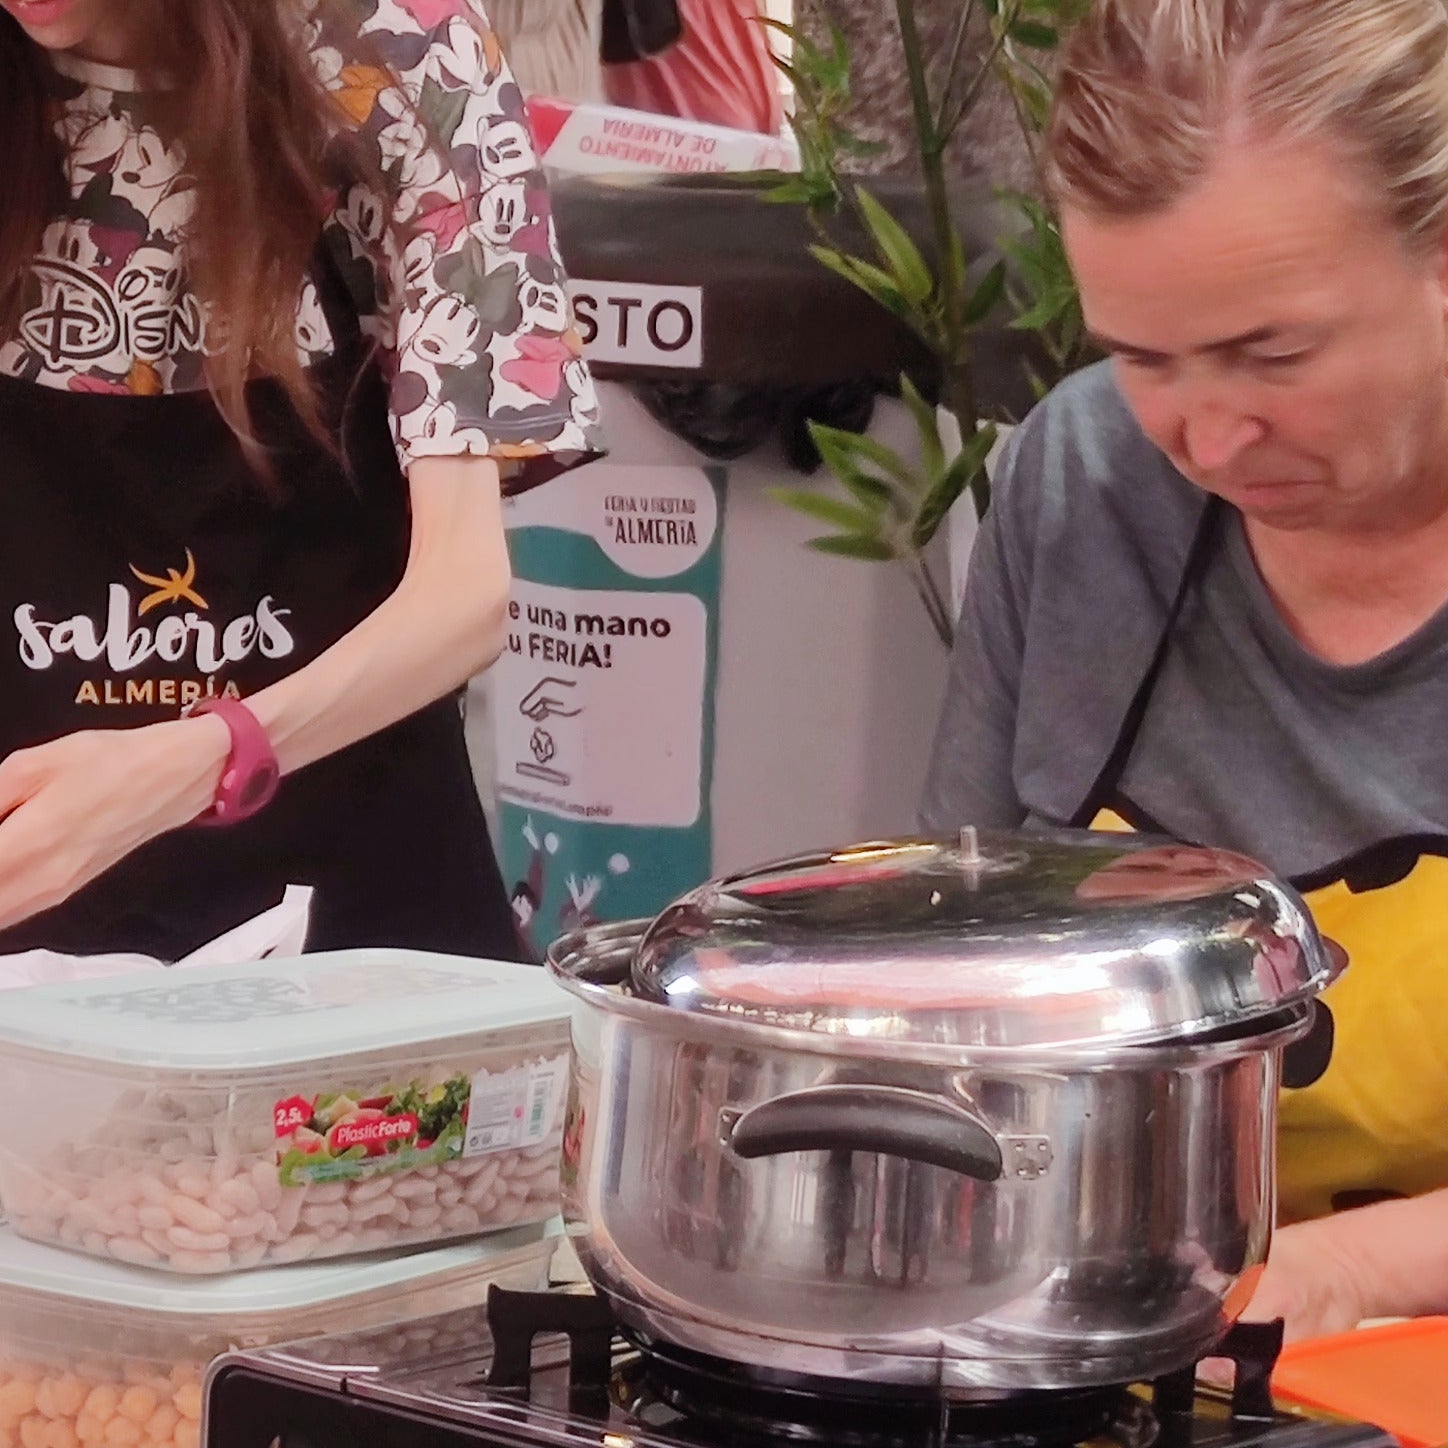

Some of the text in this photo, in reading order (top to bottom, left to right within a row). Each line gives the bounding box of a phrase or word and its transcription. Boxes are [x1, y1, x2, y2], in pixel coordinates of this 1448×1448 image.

[527, 602, 567, 632] una
[574, 612, 672, 639] mano
[528, 631, 613, 670] FERIA!
